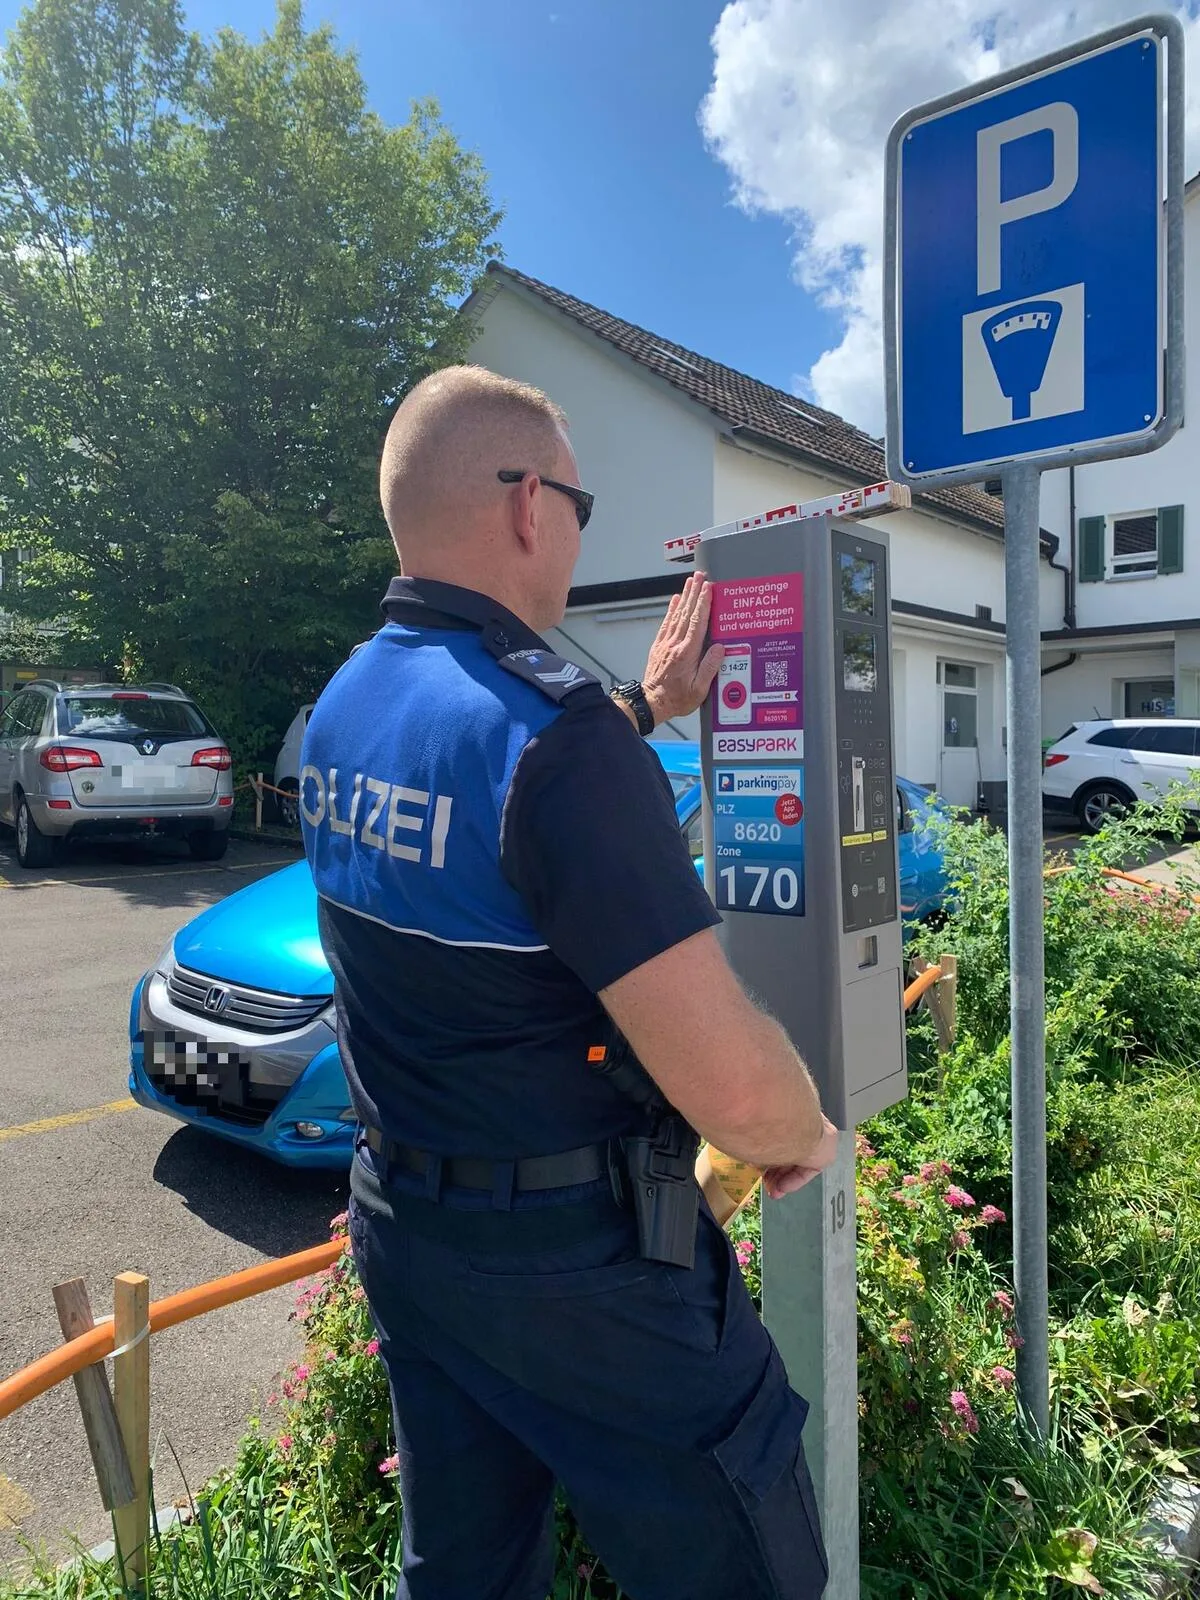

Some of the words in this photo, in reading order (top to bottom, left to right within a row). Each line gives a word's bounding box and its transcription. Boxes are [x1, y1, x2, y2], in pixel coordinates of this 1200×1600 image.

[977, 101, 1079, 296] P
[723, 582, 789, 596] Parkvorgänge
[733, 594, 779, 609] EINFACH
[719, 611, 754, 621] starten,
[755, 607, 794, 619] stoppen
[719, 621, 737, 632] und
[738, 616, 793, 630] verlängern!
[728, 662, 748, 671] 14:27
[737, 777, 797, 791] parkingpay
[716, 804, 735, 815] PLZ
[734, 823, 781, 841] 8620
[717, 845, 741, 857] Zone
[720, 865, 798, 910] 170
[830, 1189, 846, 1235] 19
